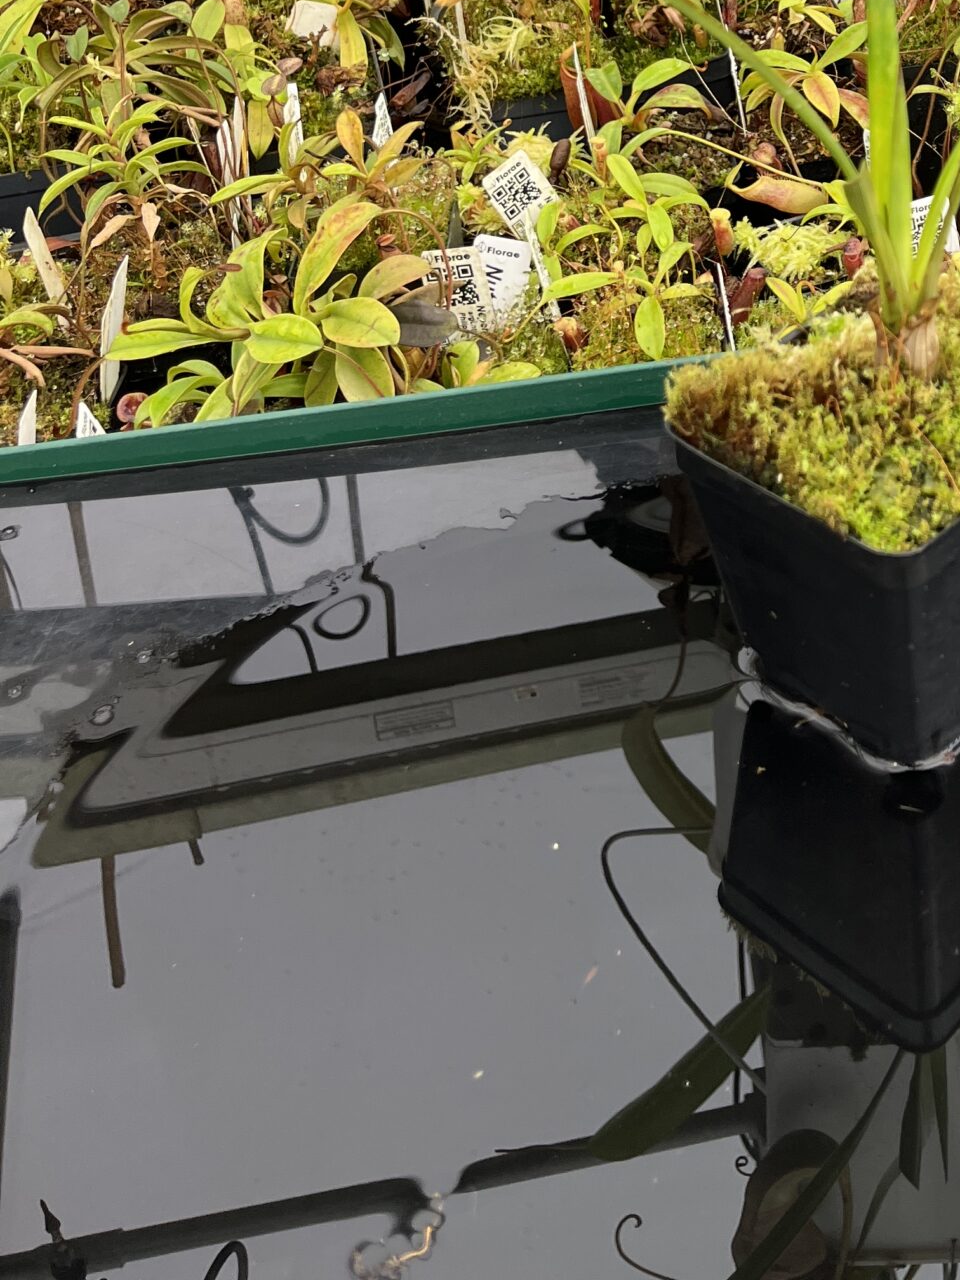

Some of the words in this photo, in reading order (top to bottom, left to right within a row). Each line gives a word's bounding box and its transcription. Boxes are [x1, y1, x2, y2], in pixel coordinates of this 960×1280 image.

[495, 160, 521, 184] Florae
[434, 253, 471, 263] Florae
[487, 246, 520, 259] Florae
